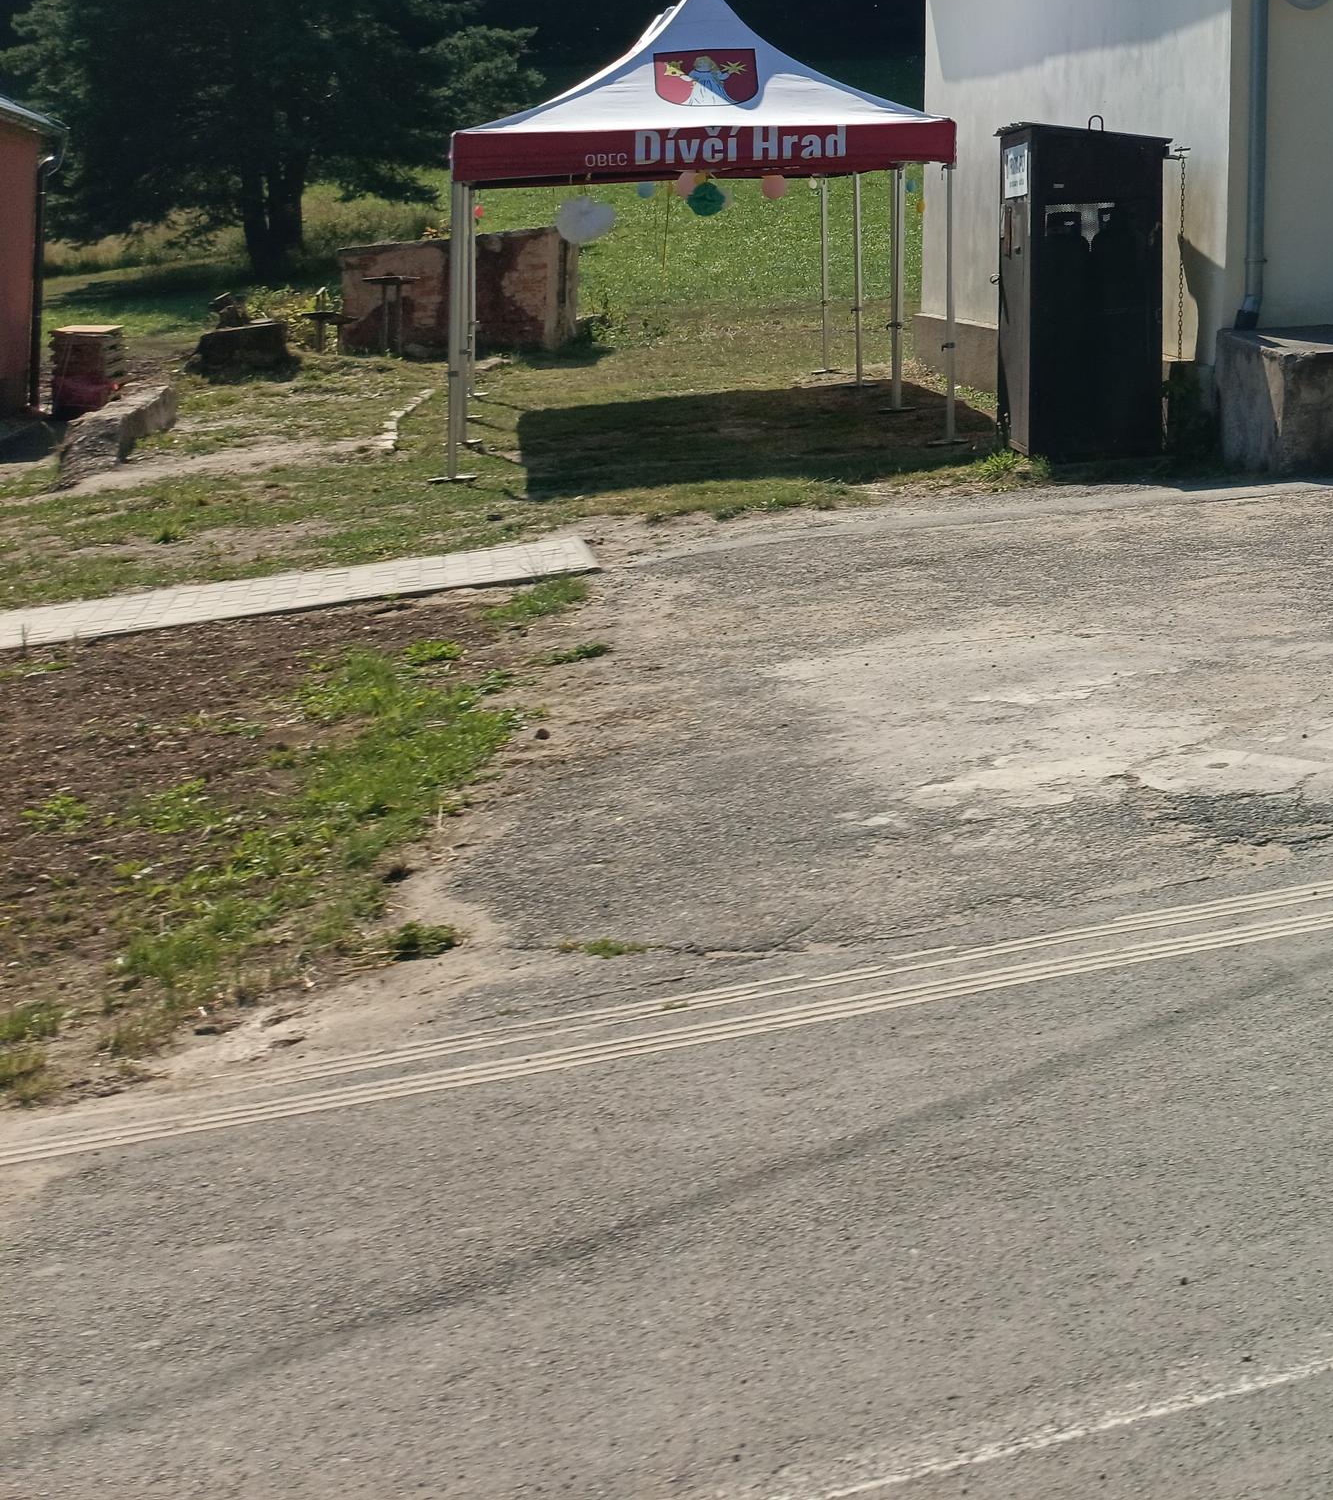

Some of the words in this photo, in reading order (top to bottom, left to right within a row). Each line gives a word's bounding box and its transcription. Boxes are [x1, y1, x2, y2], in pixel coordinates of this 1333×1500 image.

[585, 153, 628, 167] OBEC
[635, 126, 738, 165] Dívčí
[753, 124, 847, 160] Hrad
